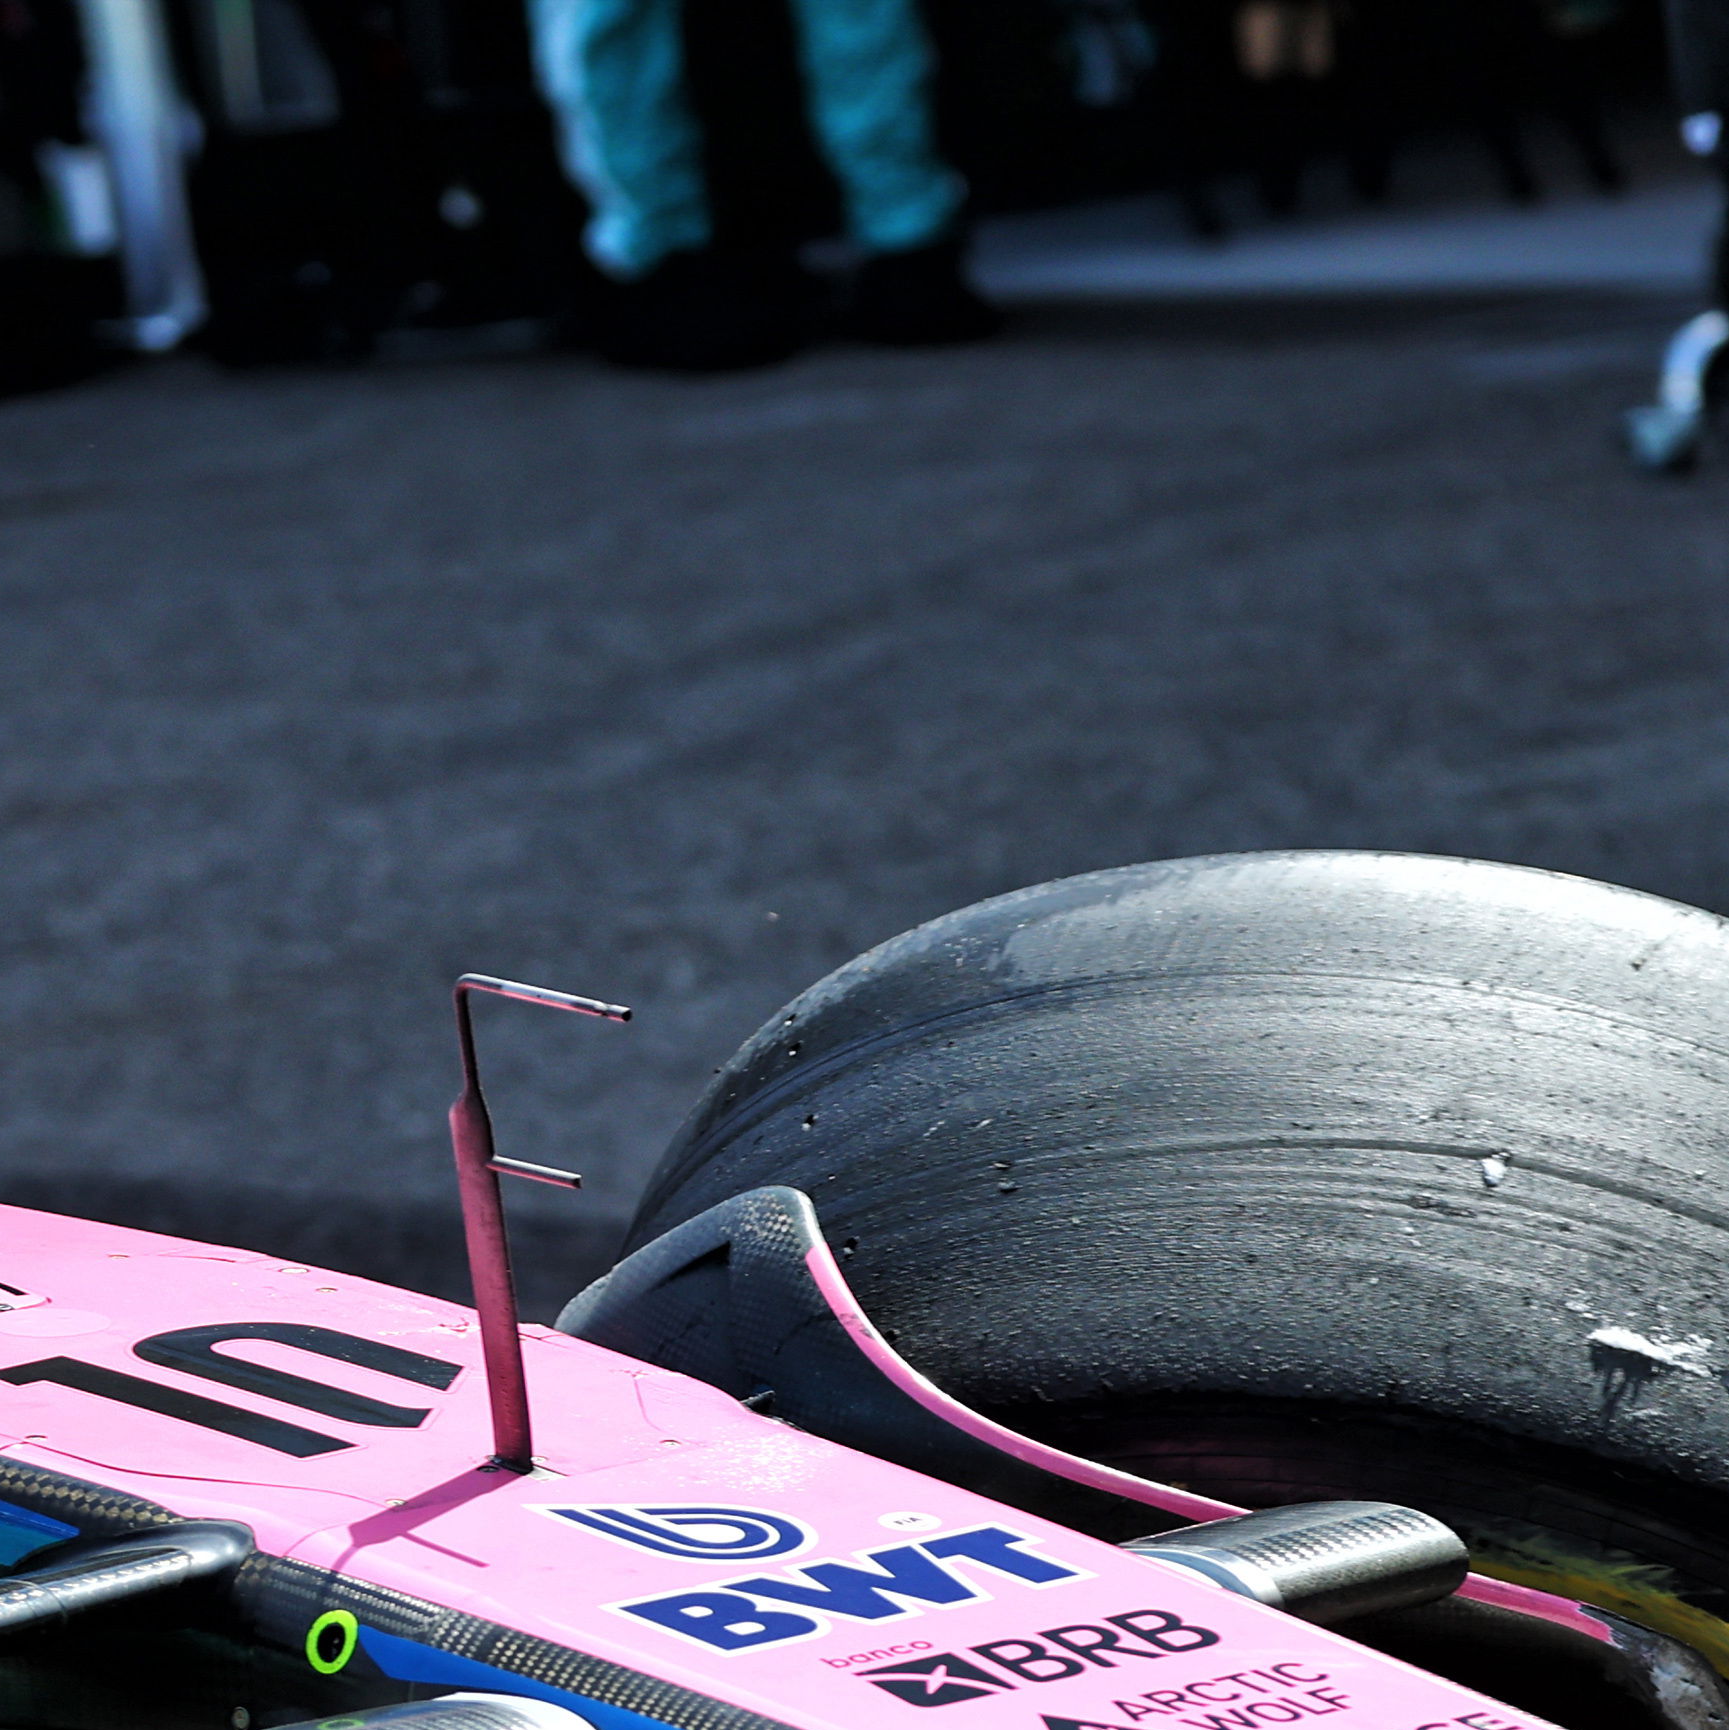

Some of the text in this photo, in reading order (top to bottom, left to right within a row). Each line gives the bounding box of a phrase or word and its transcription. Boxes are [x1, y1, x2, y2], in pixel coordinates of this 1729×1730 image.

[614, 1523, 1087, 1654] BWT
[819, 1609, 1221, 1684] banco BRB
[1110, 1661, 1330, 1722] ARCTIC
